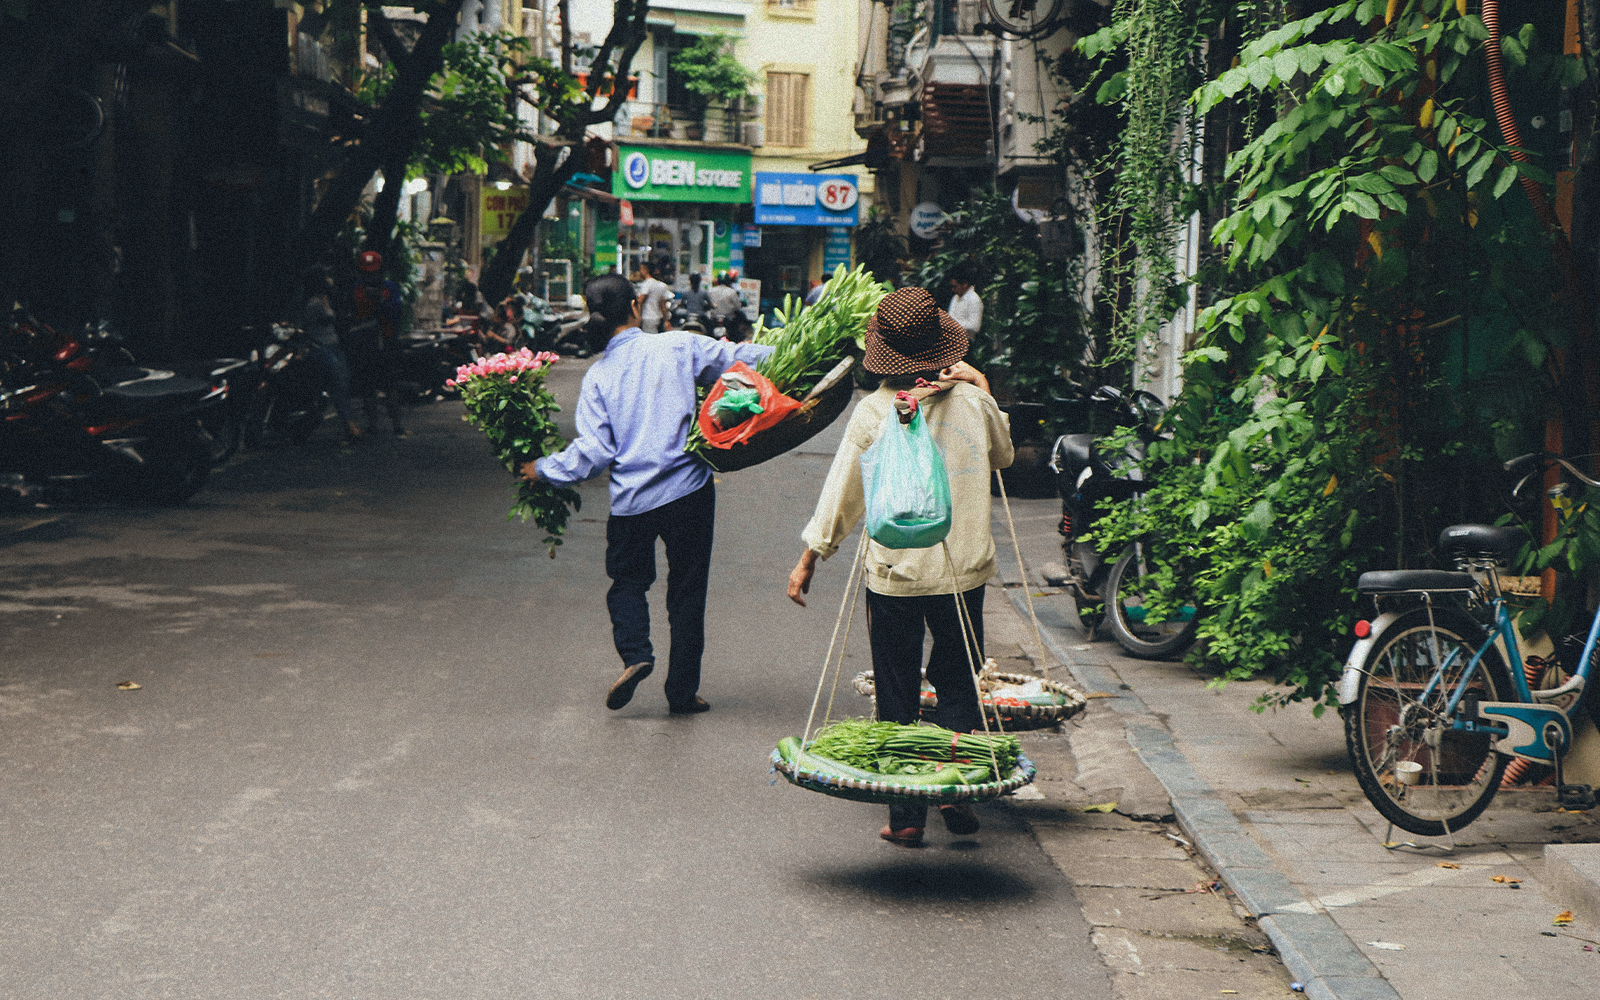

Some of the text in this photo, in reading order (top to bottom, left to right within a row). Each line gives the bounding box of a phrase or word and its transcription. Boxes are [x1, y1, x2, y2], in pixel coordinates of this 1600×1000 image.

[651, 158, 743, 188] BEN STORE
[826, 184, 851, 205] 87
[497, 213, 515, 229] 17
